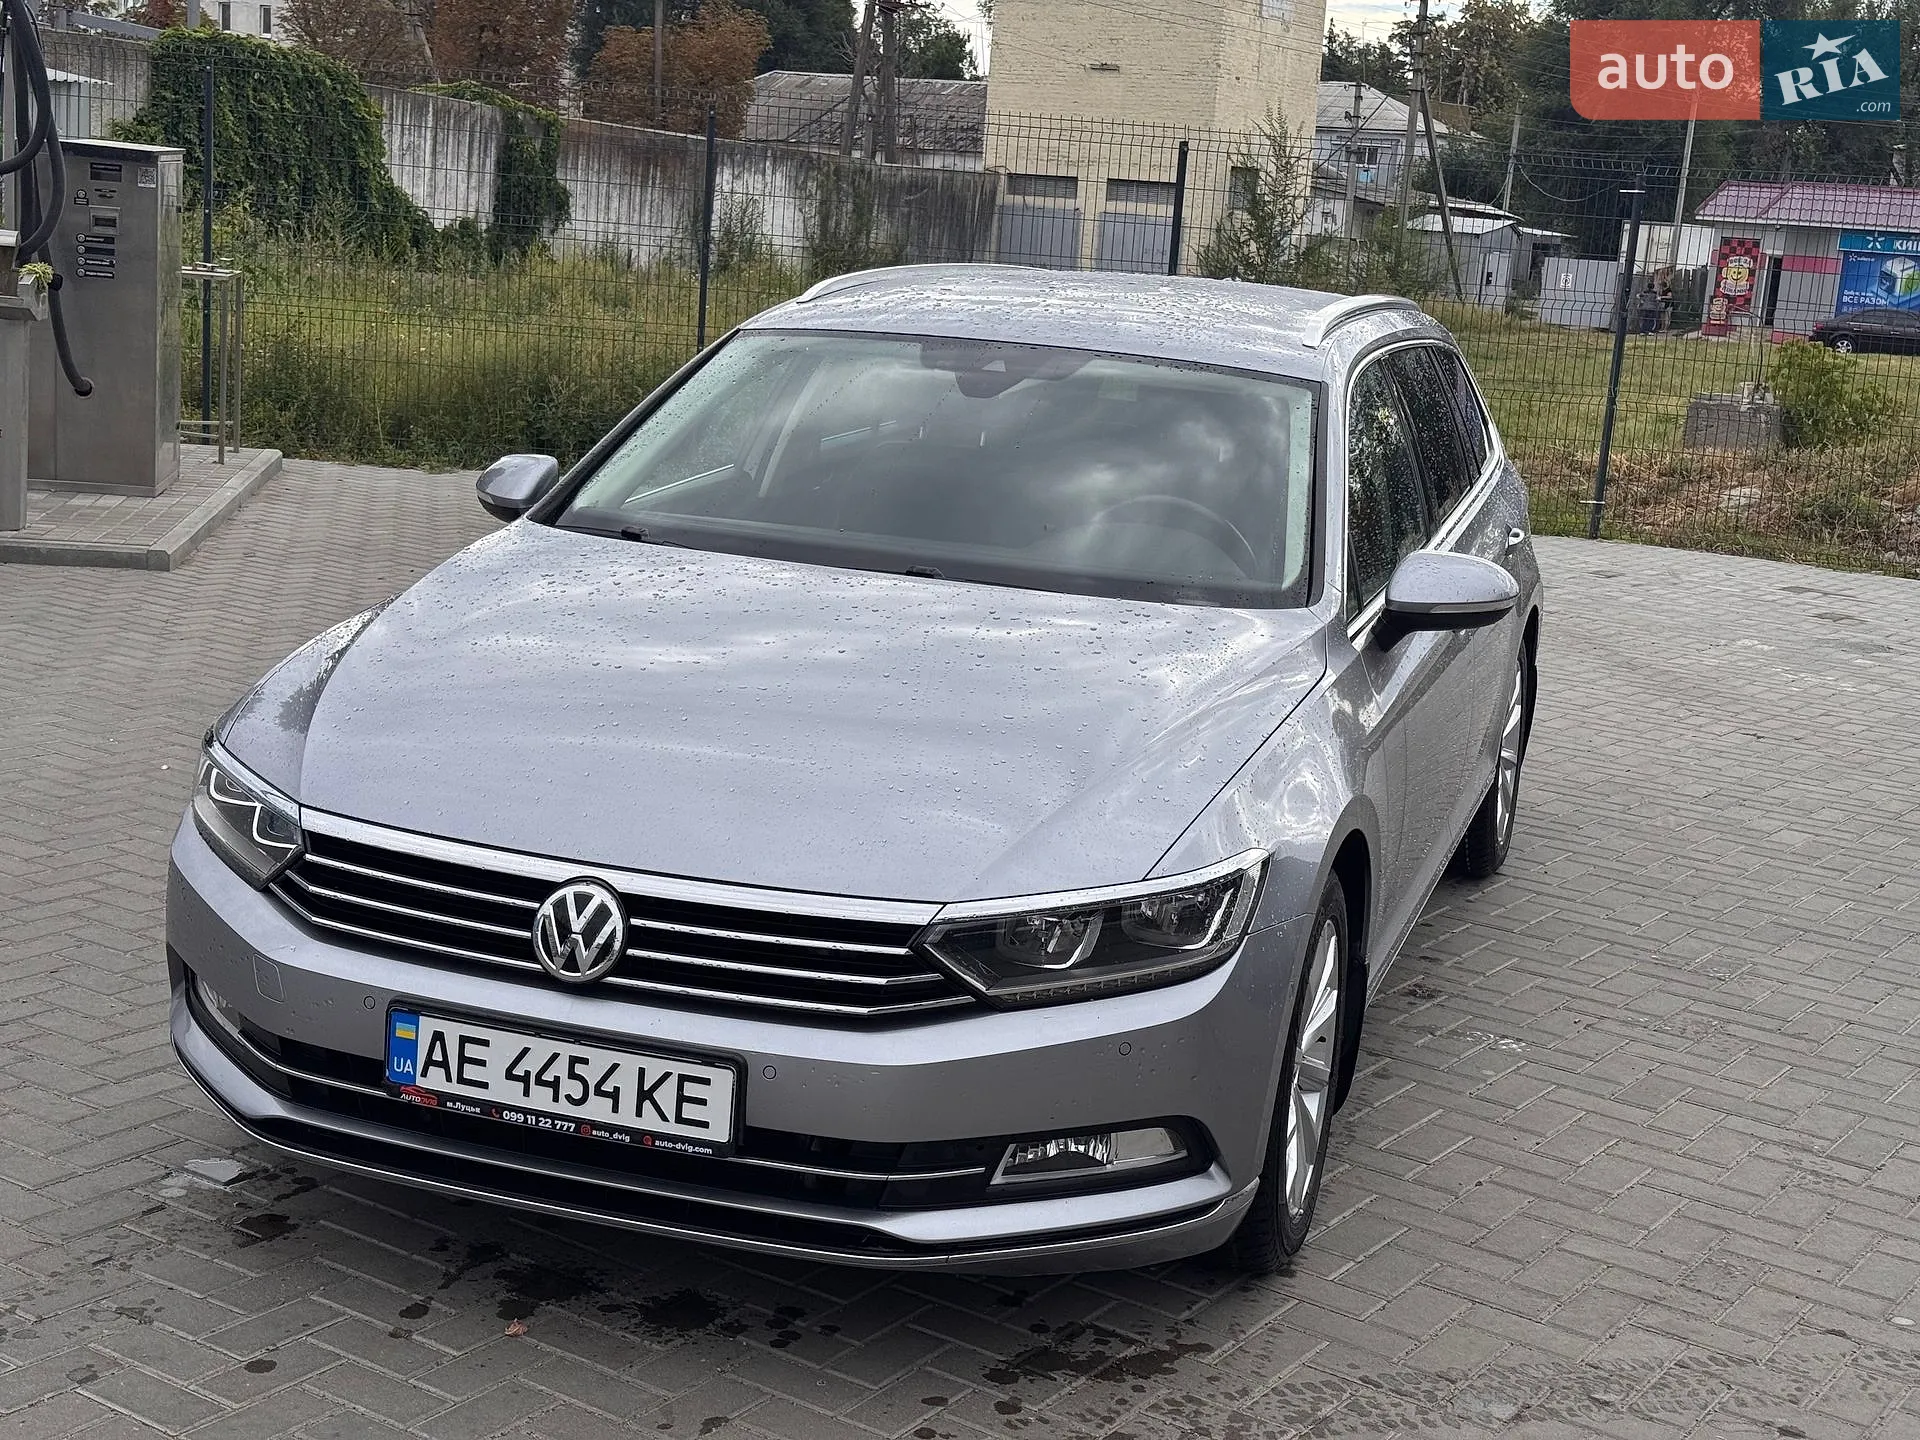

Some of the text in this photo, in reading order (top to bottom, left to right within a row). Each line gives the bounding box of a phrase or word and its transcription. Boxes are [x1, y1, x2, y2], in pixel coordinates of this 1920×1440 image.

[1842, 295, 1859, 304] ВСЕ
[393, 1056, 414, 1075] UA
[420, 1029, 712, 1129] AE 4454 KE
[502, 1110, 576, 1132] 099 11 22 777
[592, 1128, 631, 1143] auto_dvig
[655, 1139, 712, 1155] auto-dvig.com
